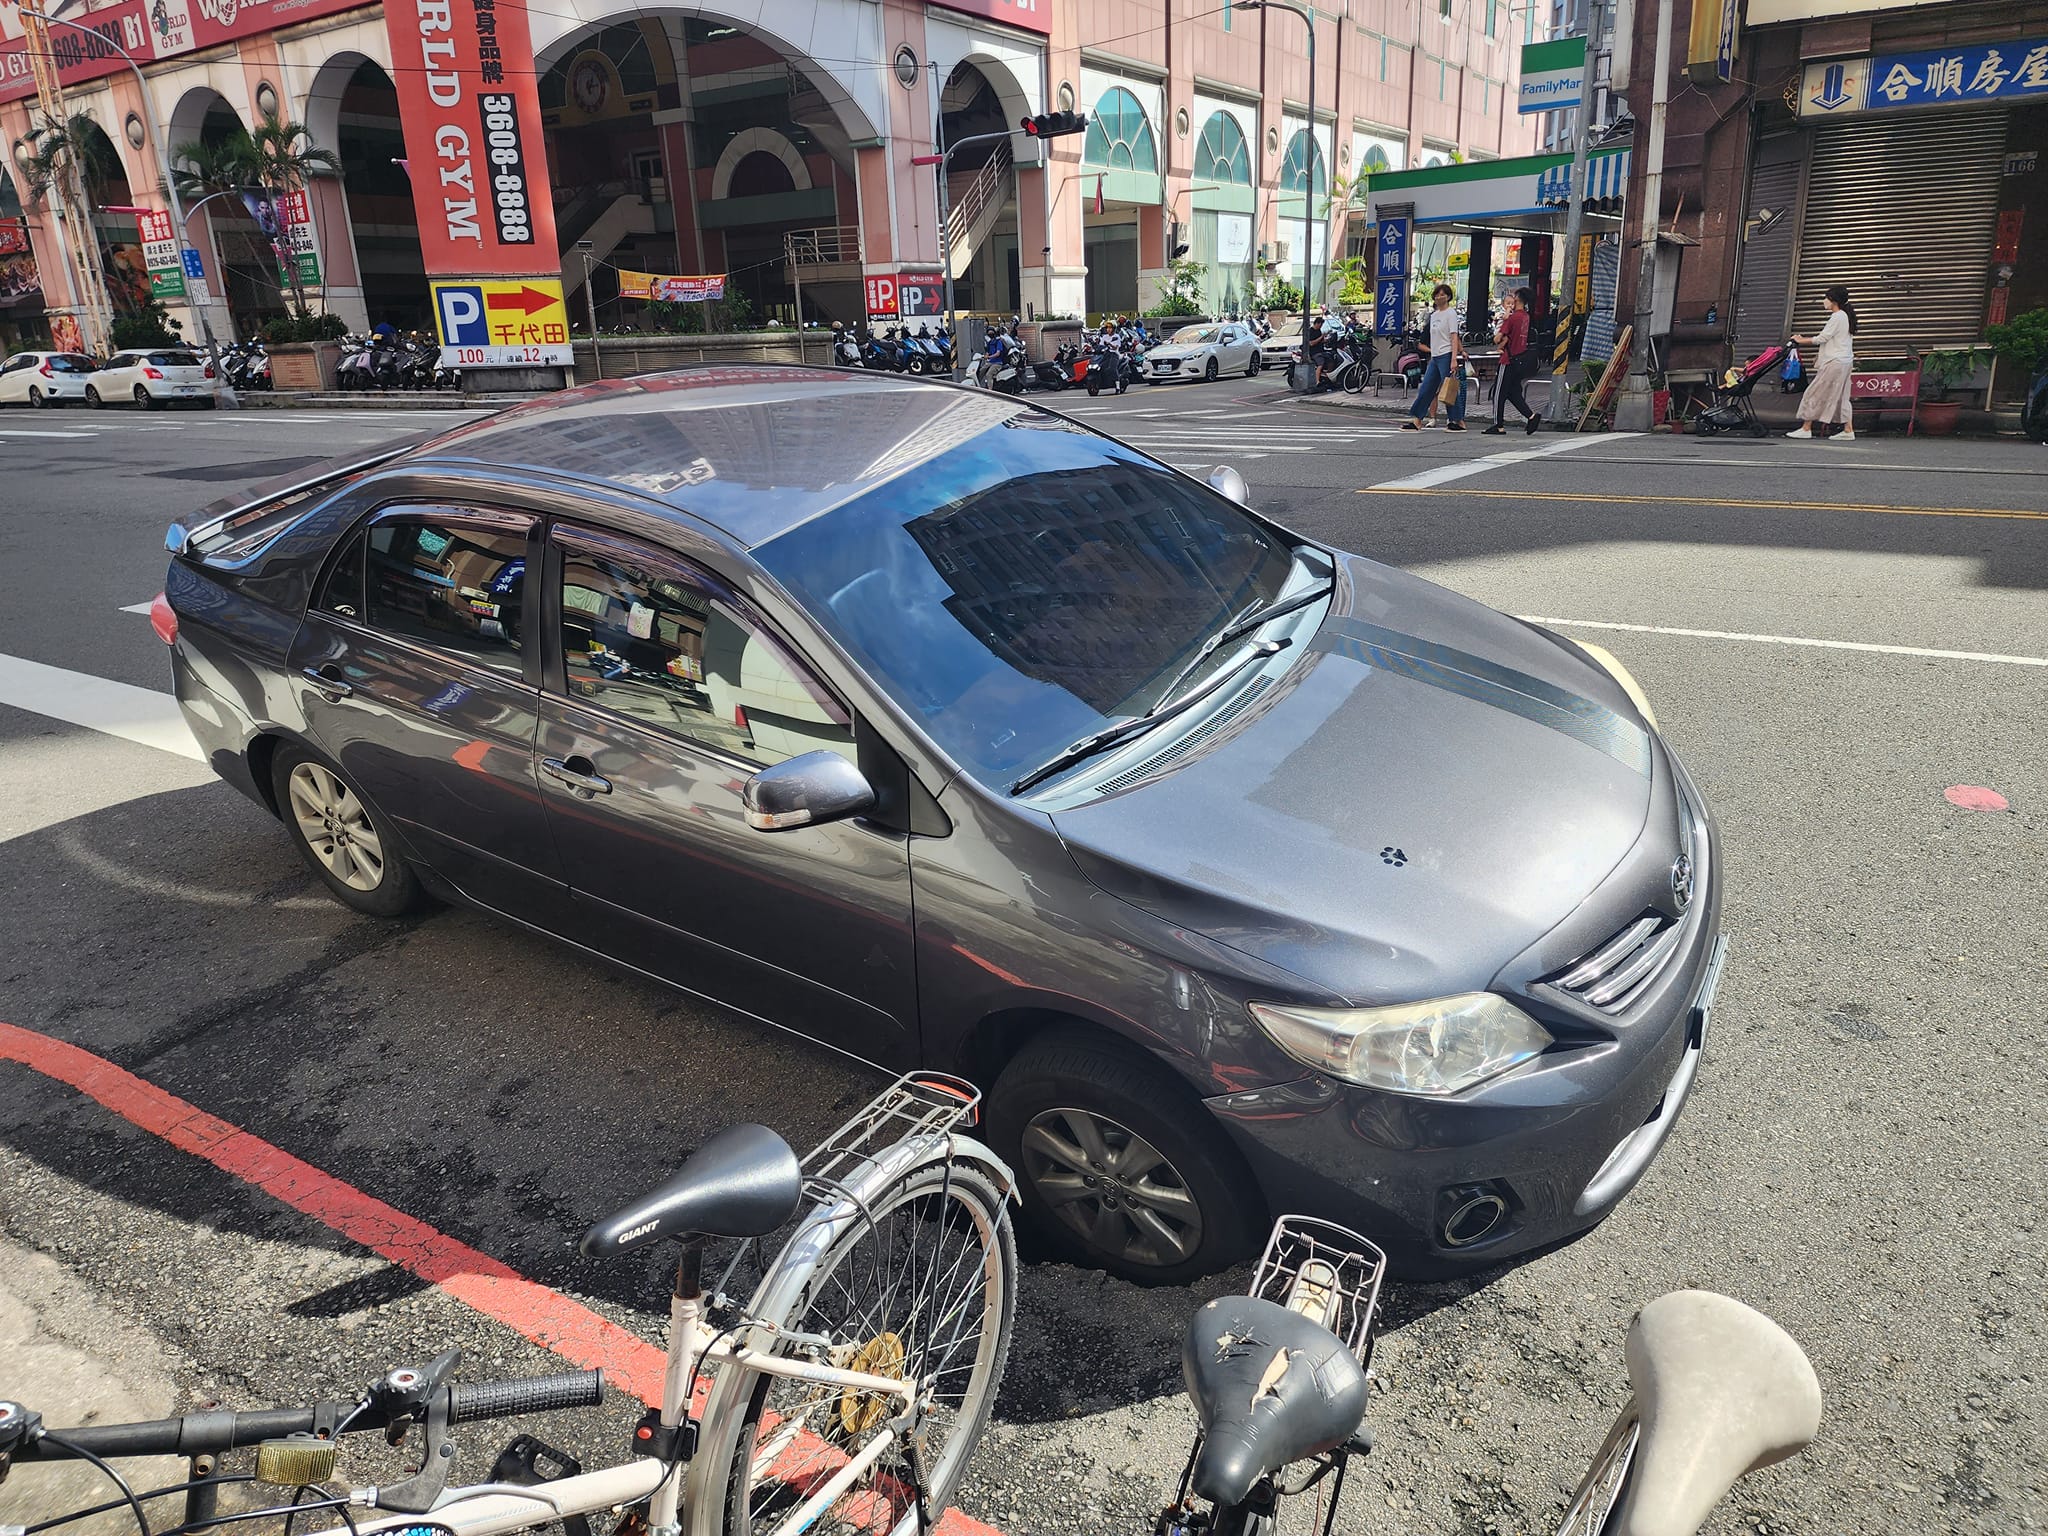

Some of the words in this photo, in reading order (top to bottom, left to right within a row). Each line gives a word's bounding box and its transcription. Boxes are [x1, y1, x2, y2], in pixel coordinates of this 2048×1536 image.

[45, 20, 124, 70] 608-8888
[123, 13, 146, 50] B1
[161, 32, 184, 49] GYM
[1522, 79, 1584, 95] FamilyMar
[1877, 45, 2048, 101] 合順房屋
[435, 124, 481, 241] GYM
[483, 95, 530, 242] 3608-8888
[878, 280, 894, 309] P
[1380, 223, 1402, 330] 合順房屋
[441, 292, 480, 344] P
[909, 287, 922, 314] P
[494, 323, 565, 345] 千代田
[618, 1219, 660, 1244] GIANT
